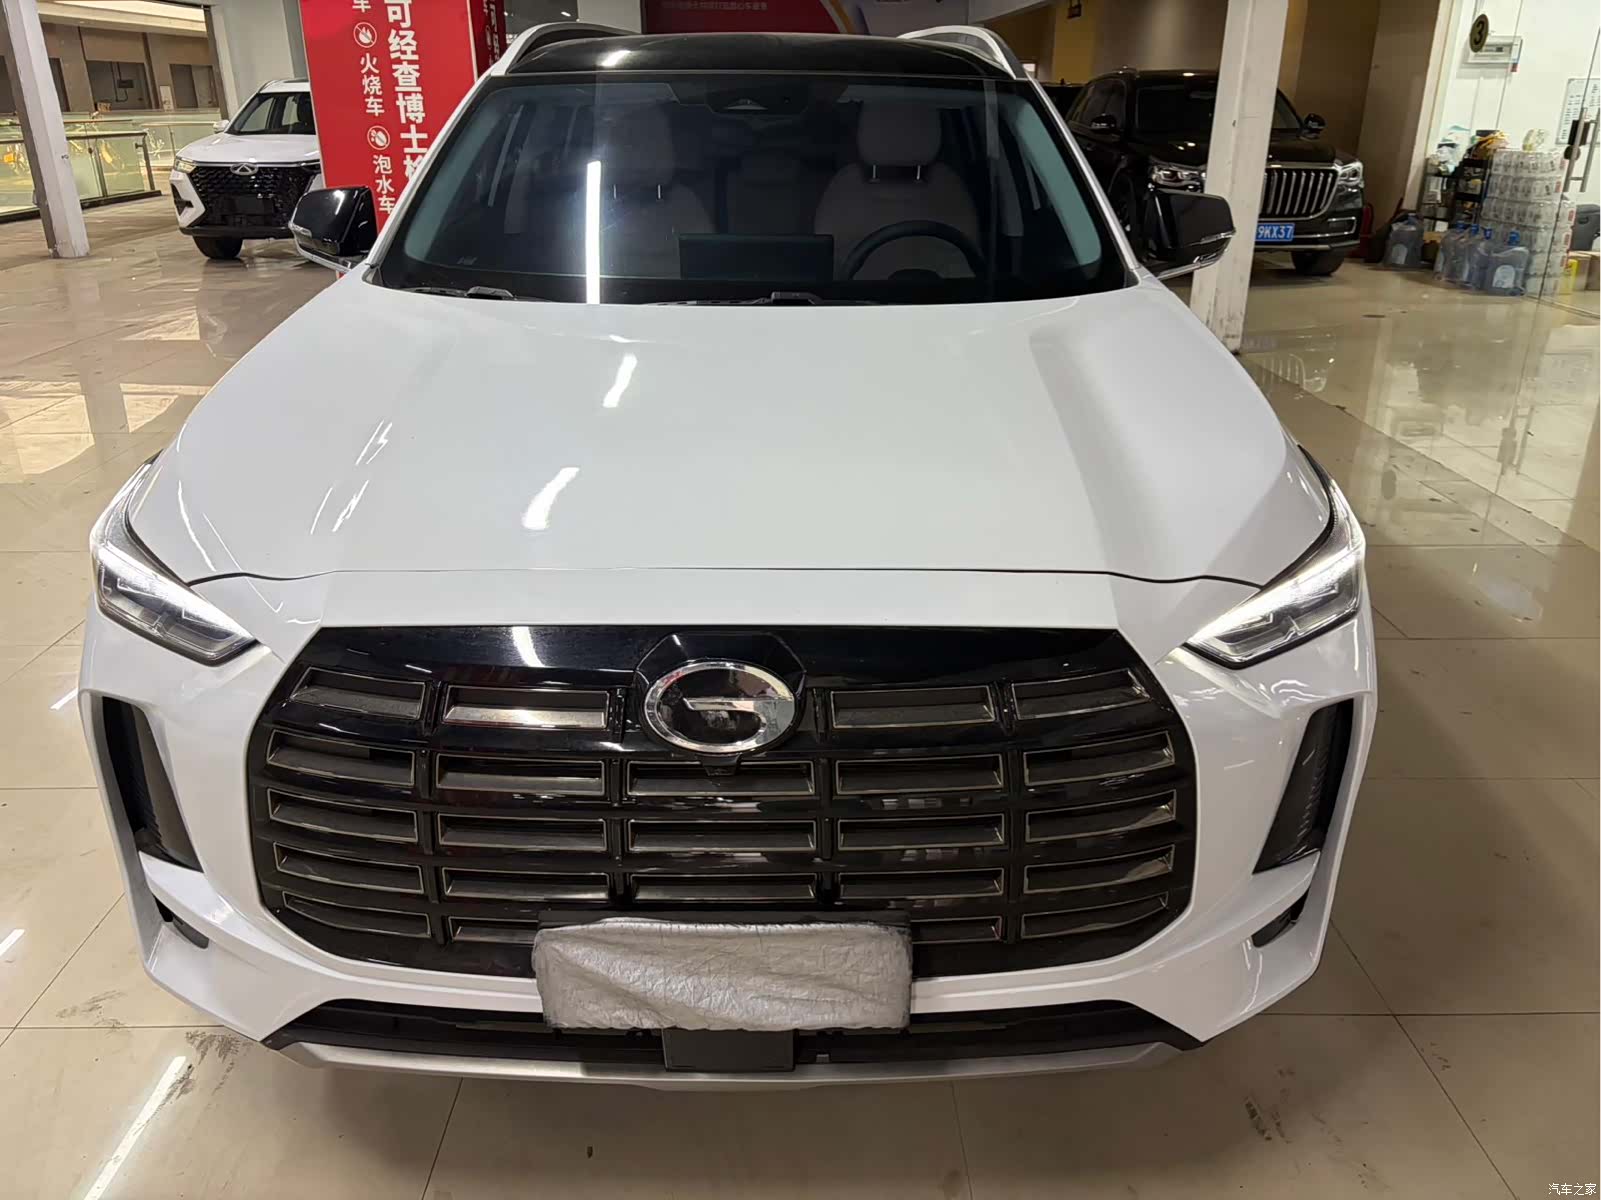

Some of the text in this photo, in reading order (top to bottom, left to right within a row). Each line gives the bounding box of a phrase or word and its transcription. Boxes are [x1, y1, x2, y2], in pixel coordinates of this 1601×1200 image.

[1474, 20, 1485, 46] 3
[360, 53, 385, 116] 火烧车
[373, 155, 396, 214] 泡水车
